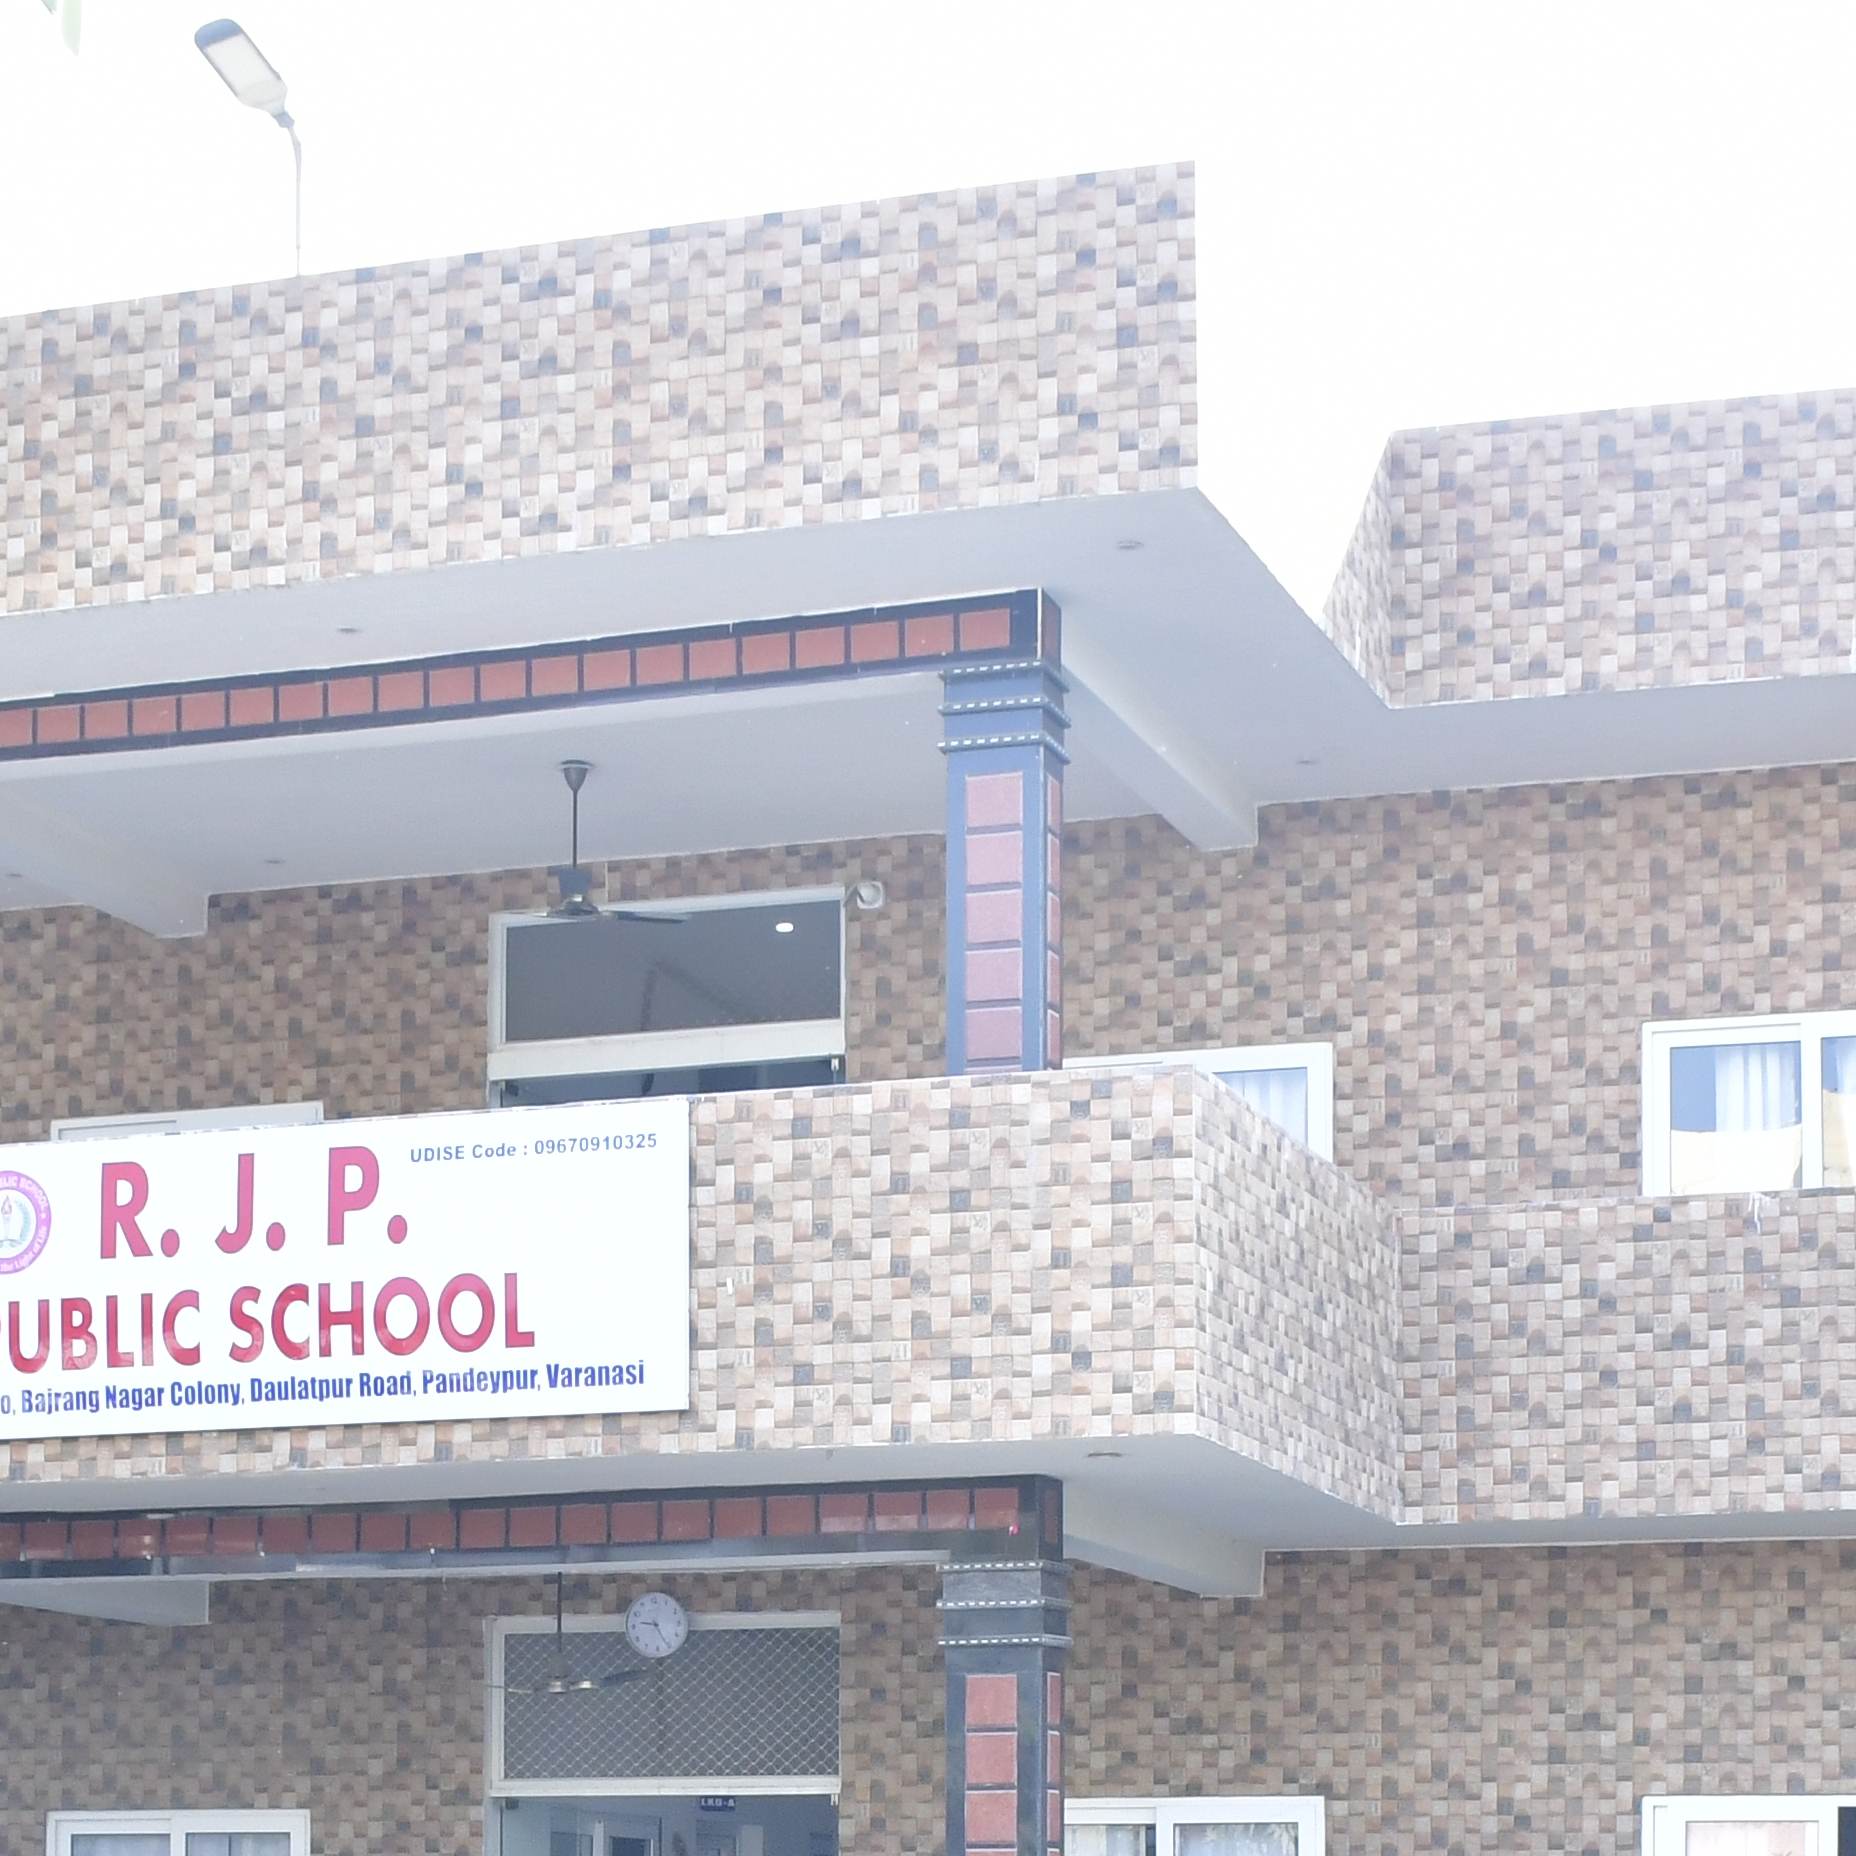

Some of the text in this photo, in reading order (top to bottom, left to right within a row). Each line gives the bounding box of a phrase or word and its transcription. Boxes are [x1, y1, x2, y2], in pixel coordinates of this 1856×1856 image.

[409, 1145, 465, 1163] UDISE
[471, 1143, 517, 1159] Code
[534, 1133, 657, 1155] 09670910325
[228, 1273, 535, 1362] SCHOOL
[21, 1388, 100, 1415] Bajrang
[105, 1385, 165, 1412] Nagar
[170, 1381, 245, 1408] Colony,
[250, 1375, 354, 1402] Daulatpur
[359, 1371, 417, 1398] Road,
[422, 1367, 542, 1396] Pandeypur,
[546, 1360, 645, 1389] Varanasi
